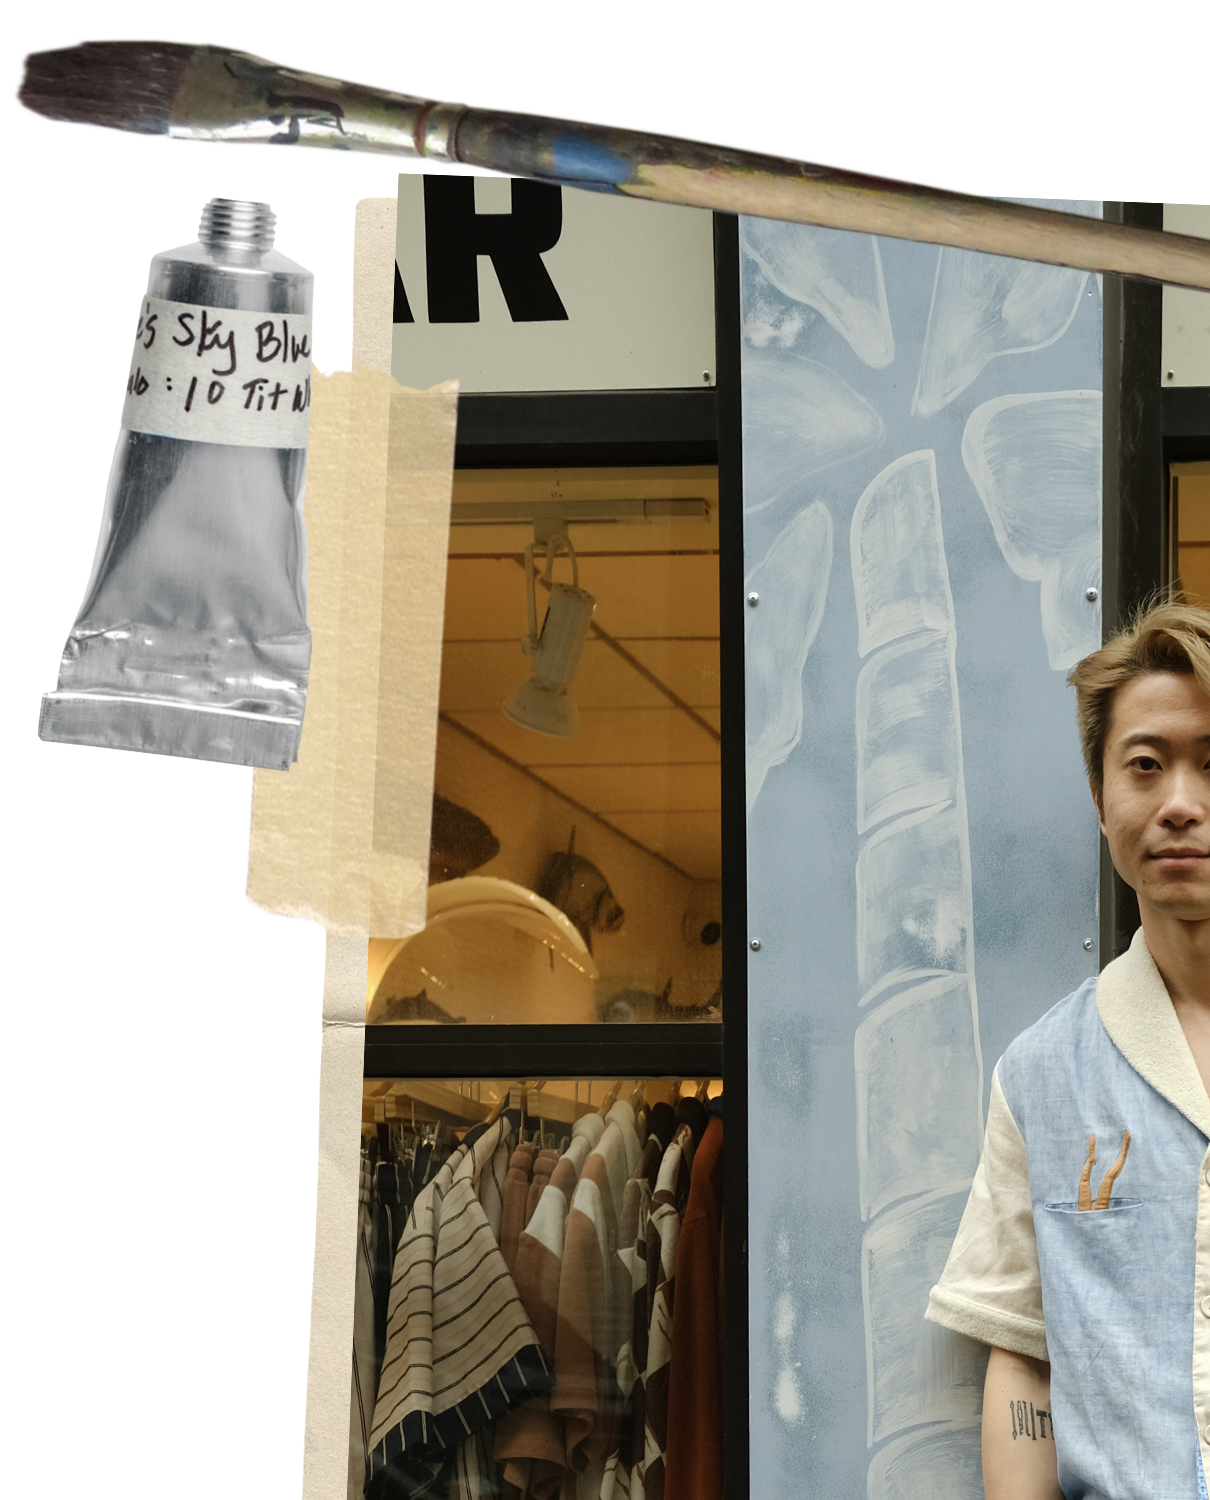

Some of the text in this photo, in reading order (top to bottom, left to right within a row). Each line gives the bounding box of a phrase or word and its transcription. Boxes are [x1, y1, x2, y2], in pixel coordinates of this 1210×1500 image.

[172, 310, 237, 376] Sky
[255, 319, 311, 363] Blue
[242, 378, 289, 411] Tit
